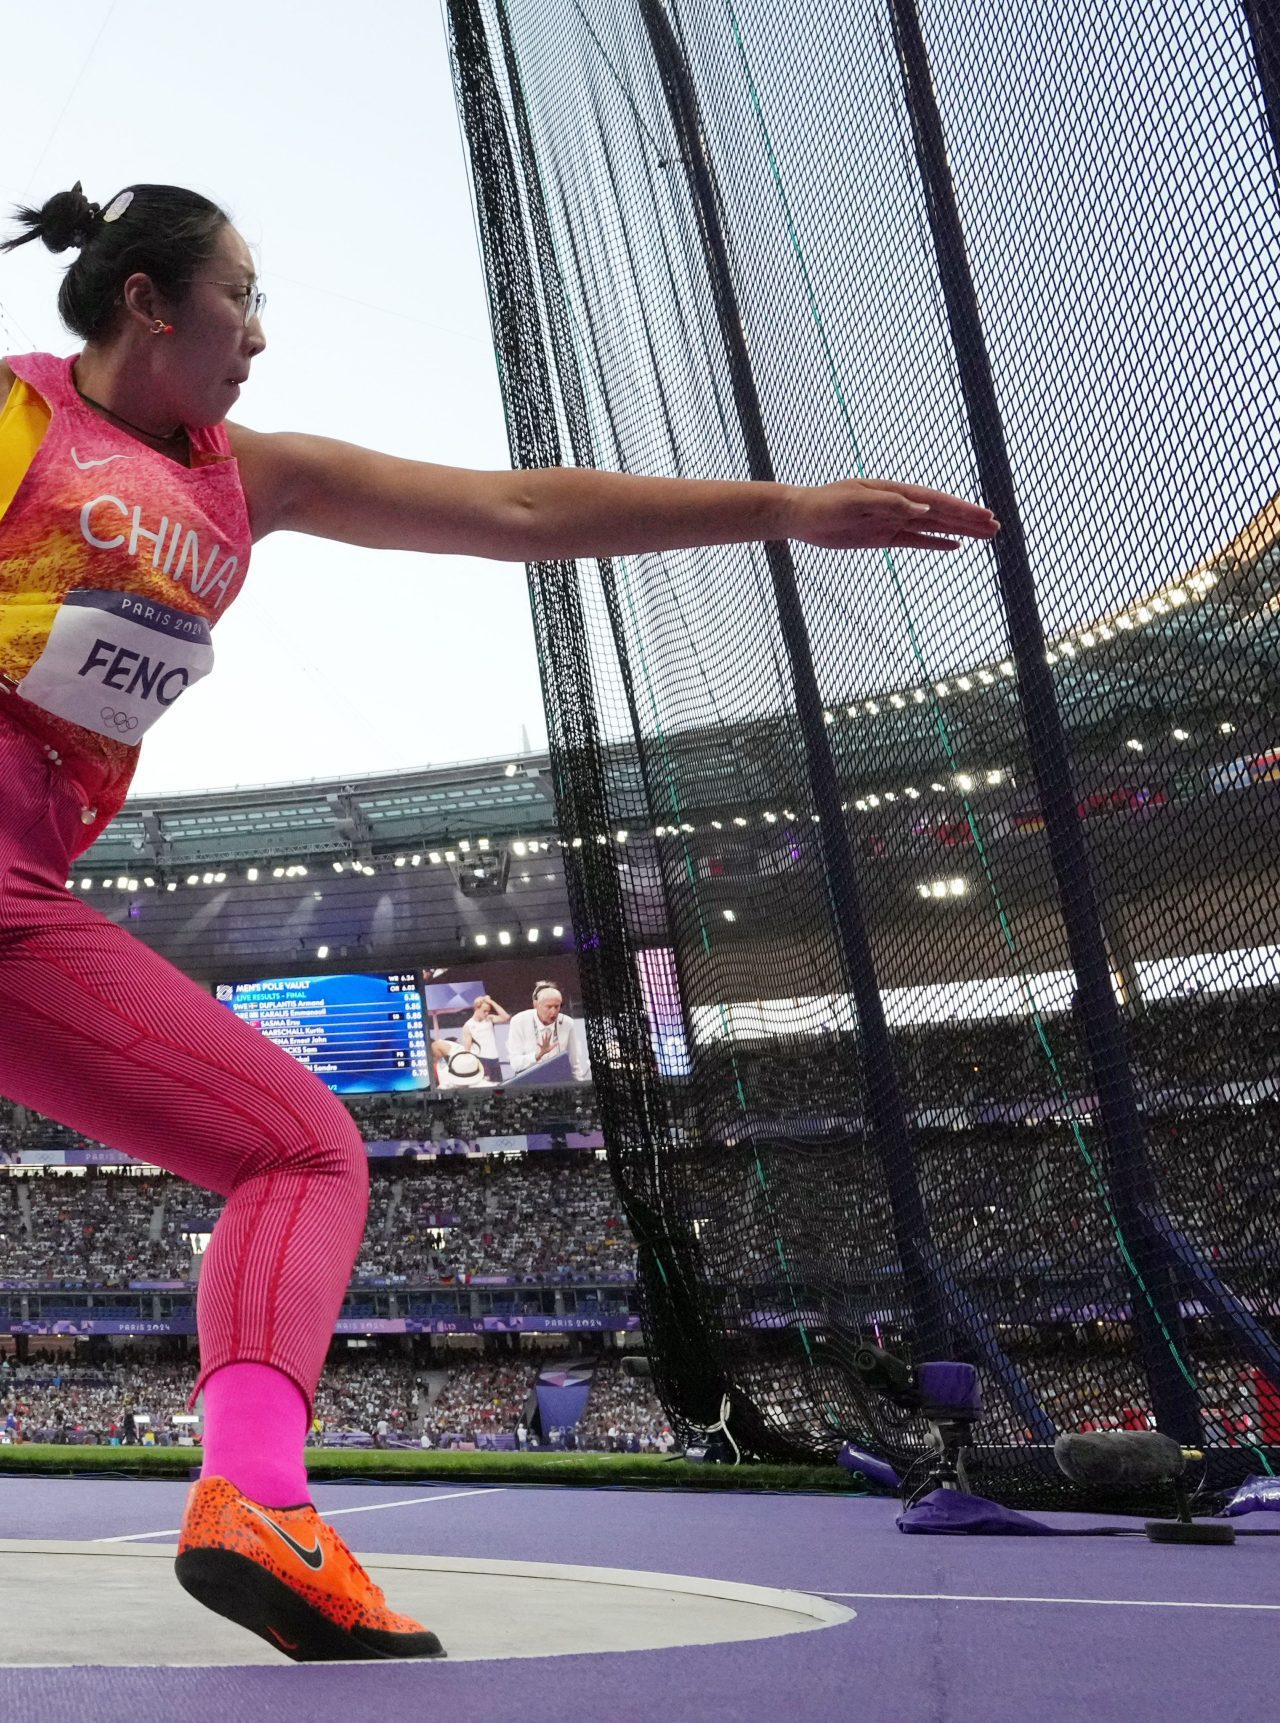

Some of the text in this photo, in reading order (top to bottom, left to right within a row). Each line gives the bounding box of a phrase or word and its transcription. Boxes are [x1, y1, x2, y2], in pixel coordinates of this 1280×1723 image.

[80, 494, 238, 608] CHINA
[121, 598, 202, 635] PARIS 2024
[262, 981, 284, 991] POLE
[285, 980, 311, 989] VAULT
[237, 993, 252, 1001] LIVE
[252, 992, 281, 1000] RESULTS
[285, 991, 307, 999] FINAL
[259, 1000, 297, 1009] DUPLANTIS
[261, 1027, 305, 1037] MARSCHALL
[311, 1036, 328, 1044] John
[313, 1063, 338, 1072] Sondre
[146, 1323, 170, 1331] 2024
[545, 1319, 602, 1328] PARIS 2024
